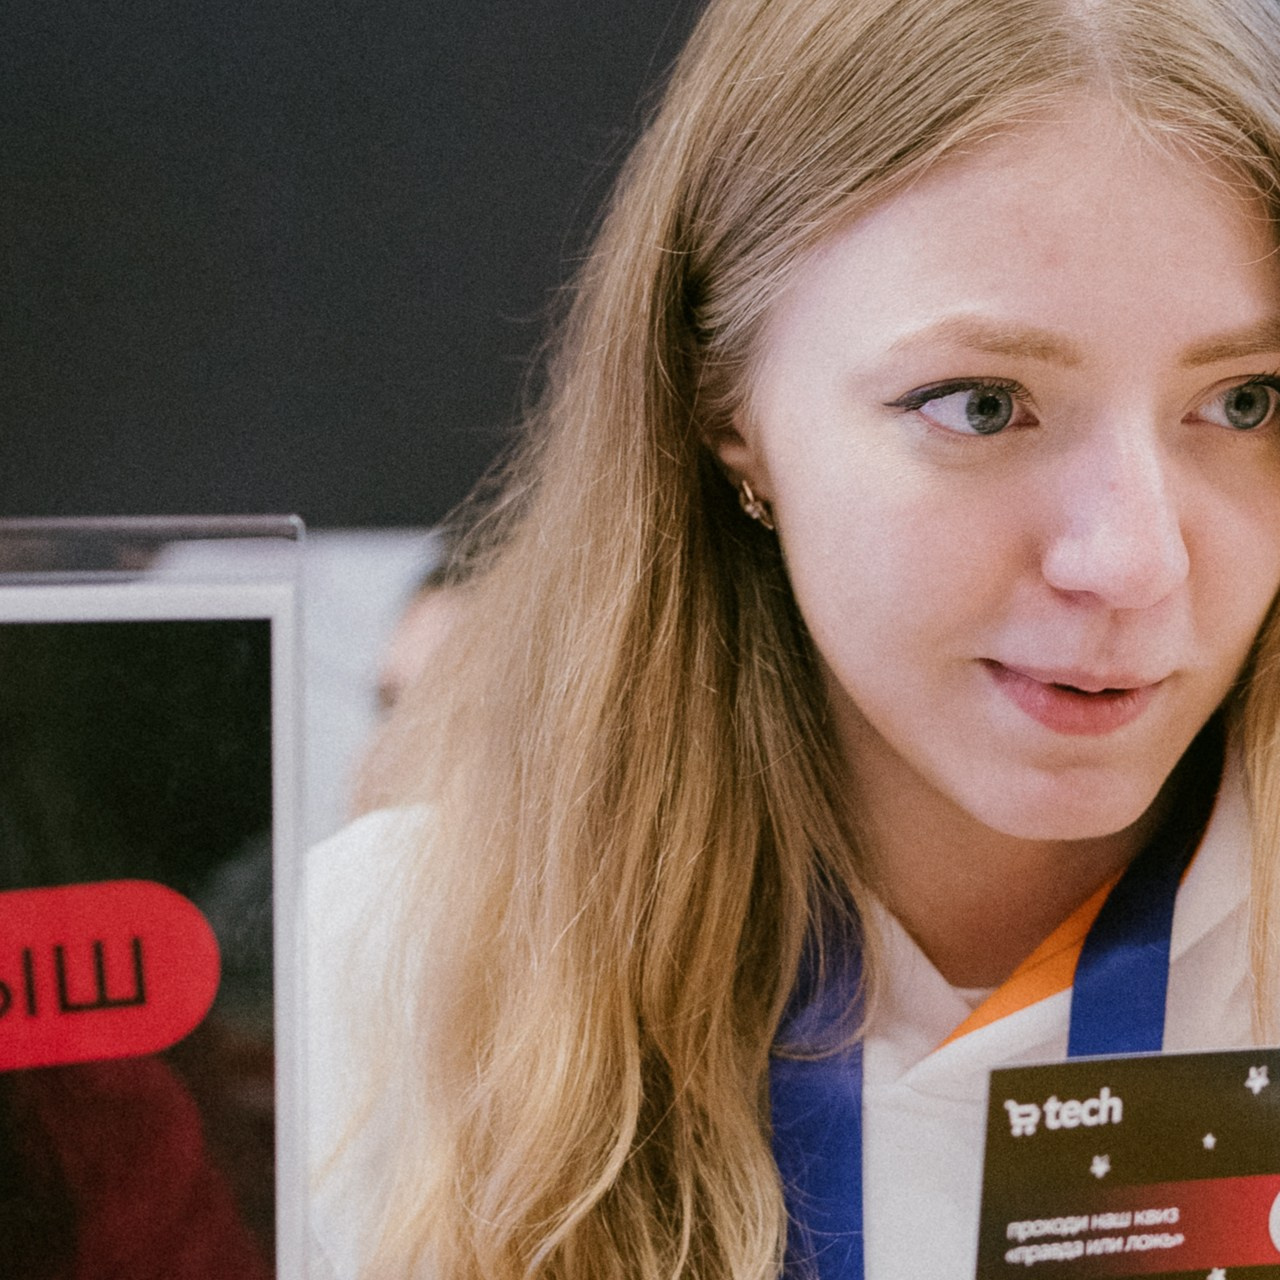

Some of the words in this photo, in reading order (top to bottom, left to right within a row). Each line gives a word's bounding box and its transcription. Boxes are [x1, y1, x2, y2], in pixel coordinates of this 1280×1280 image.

[1043, 1087, 1123, 1130] tech
[1006, 1215, 1089, 1242] проходи
[1090, 1211, 1132, 1230] наш
[1133, 1207, 1180, 1227] квиз
[1085, 1236, 1124, 1256] или
